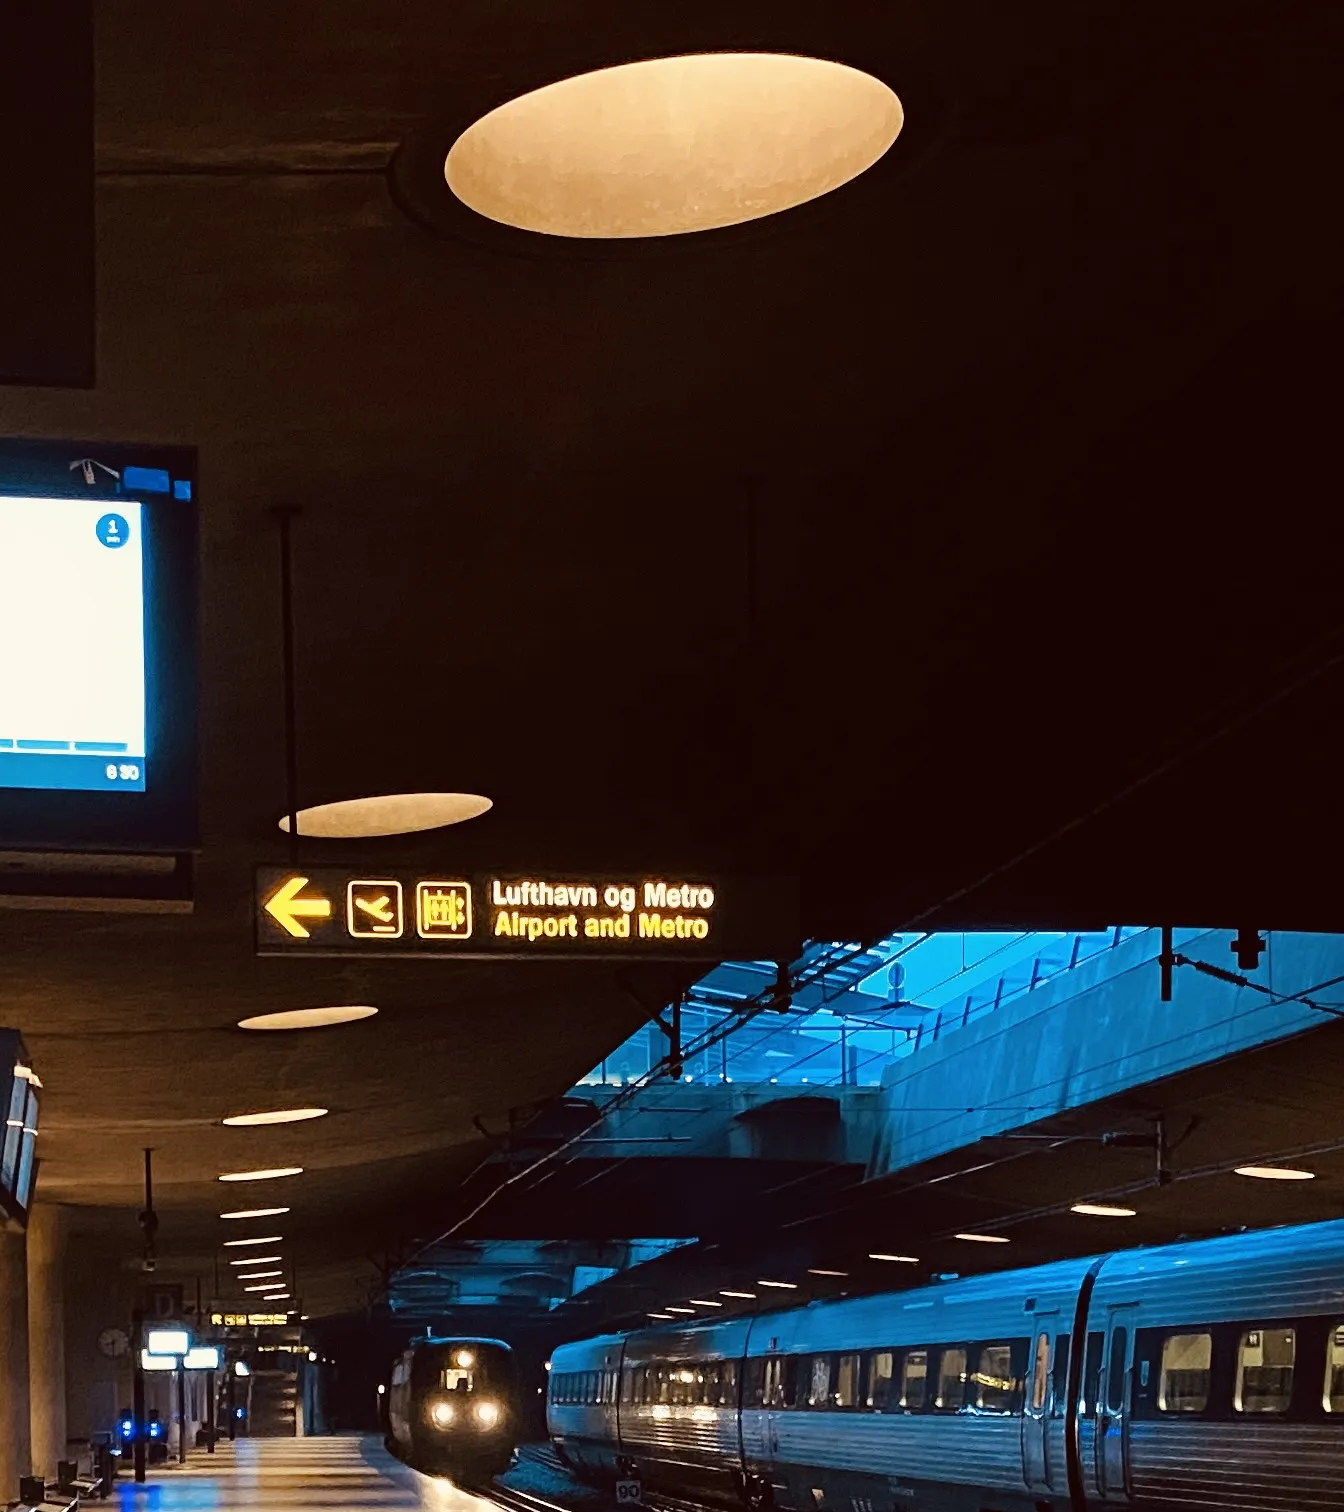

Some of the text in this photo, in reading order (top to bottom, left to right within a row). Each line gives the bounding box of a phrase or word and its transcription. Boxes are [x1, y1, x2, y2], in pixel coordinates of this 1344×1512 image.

[108, 519, 119, 534] 1
[492, 880, 715, 912] Lufthavn og Metro
[494, 911, 709, 941] Airport and Metro
